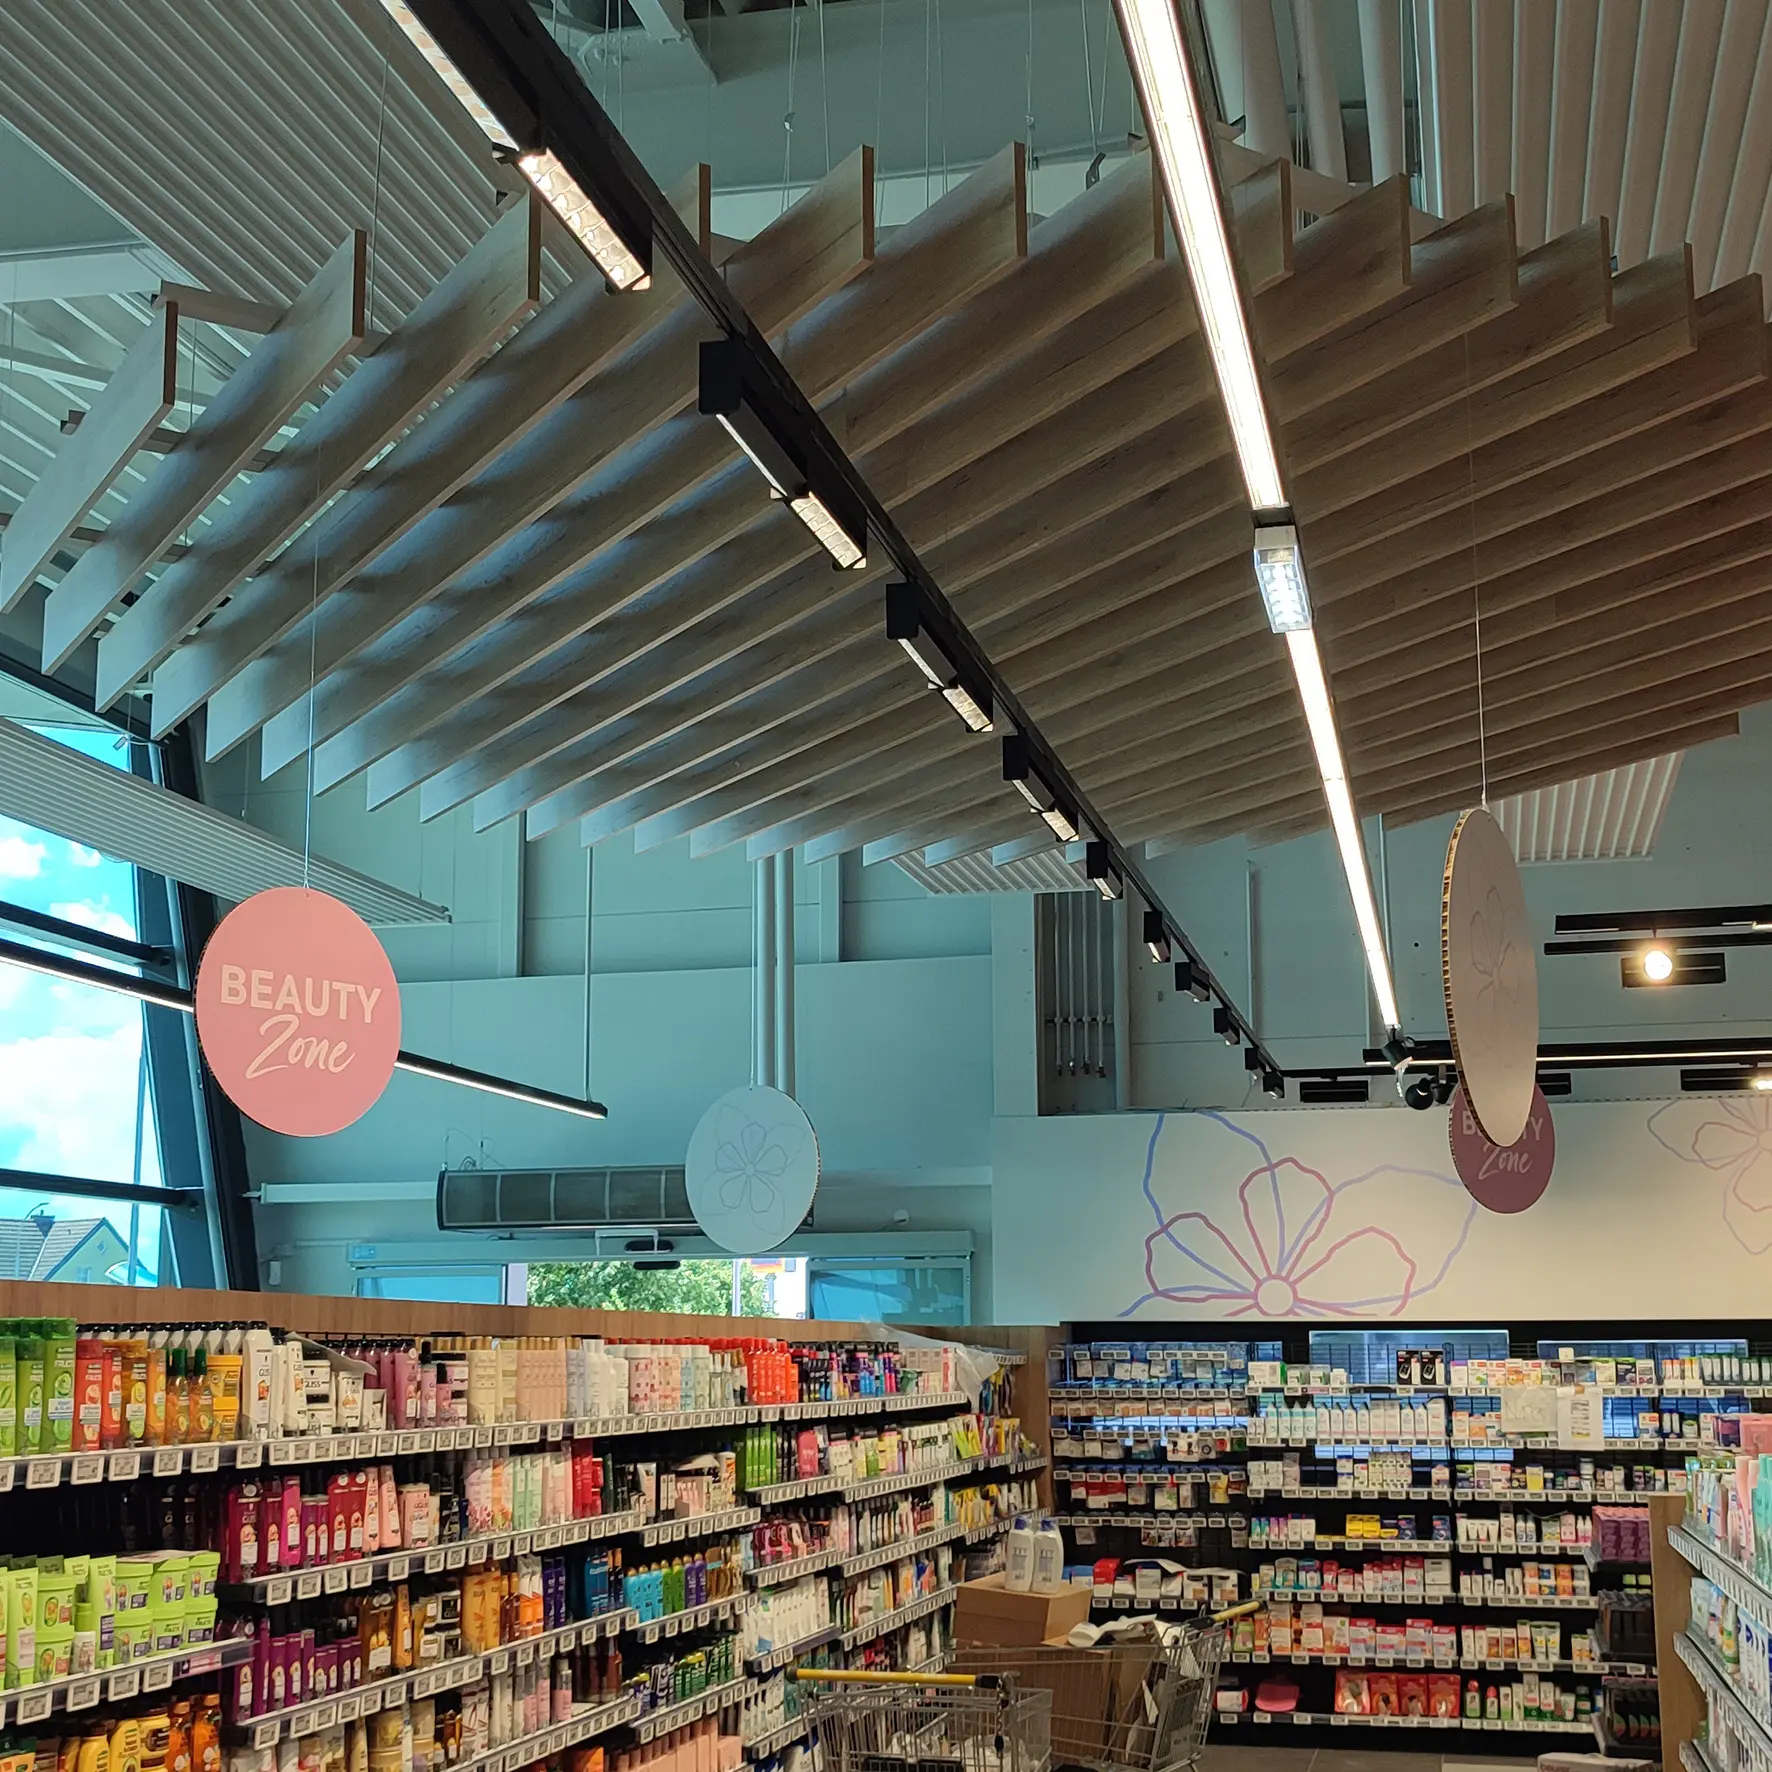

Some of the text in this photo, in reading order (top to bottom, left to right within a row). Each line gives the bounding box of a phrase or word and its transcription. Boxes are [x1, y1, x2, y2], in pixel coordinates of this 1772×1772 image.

[220, 964, 382, 1024] BEAUTY
[245, 1013, 356, 1080] Zone
[1478, 1142, 1533, 1180] Zone
